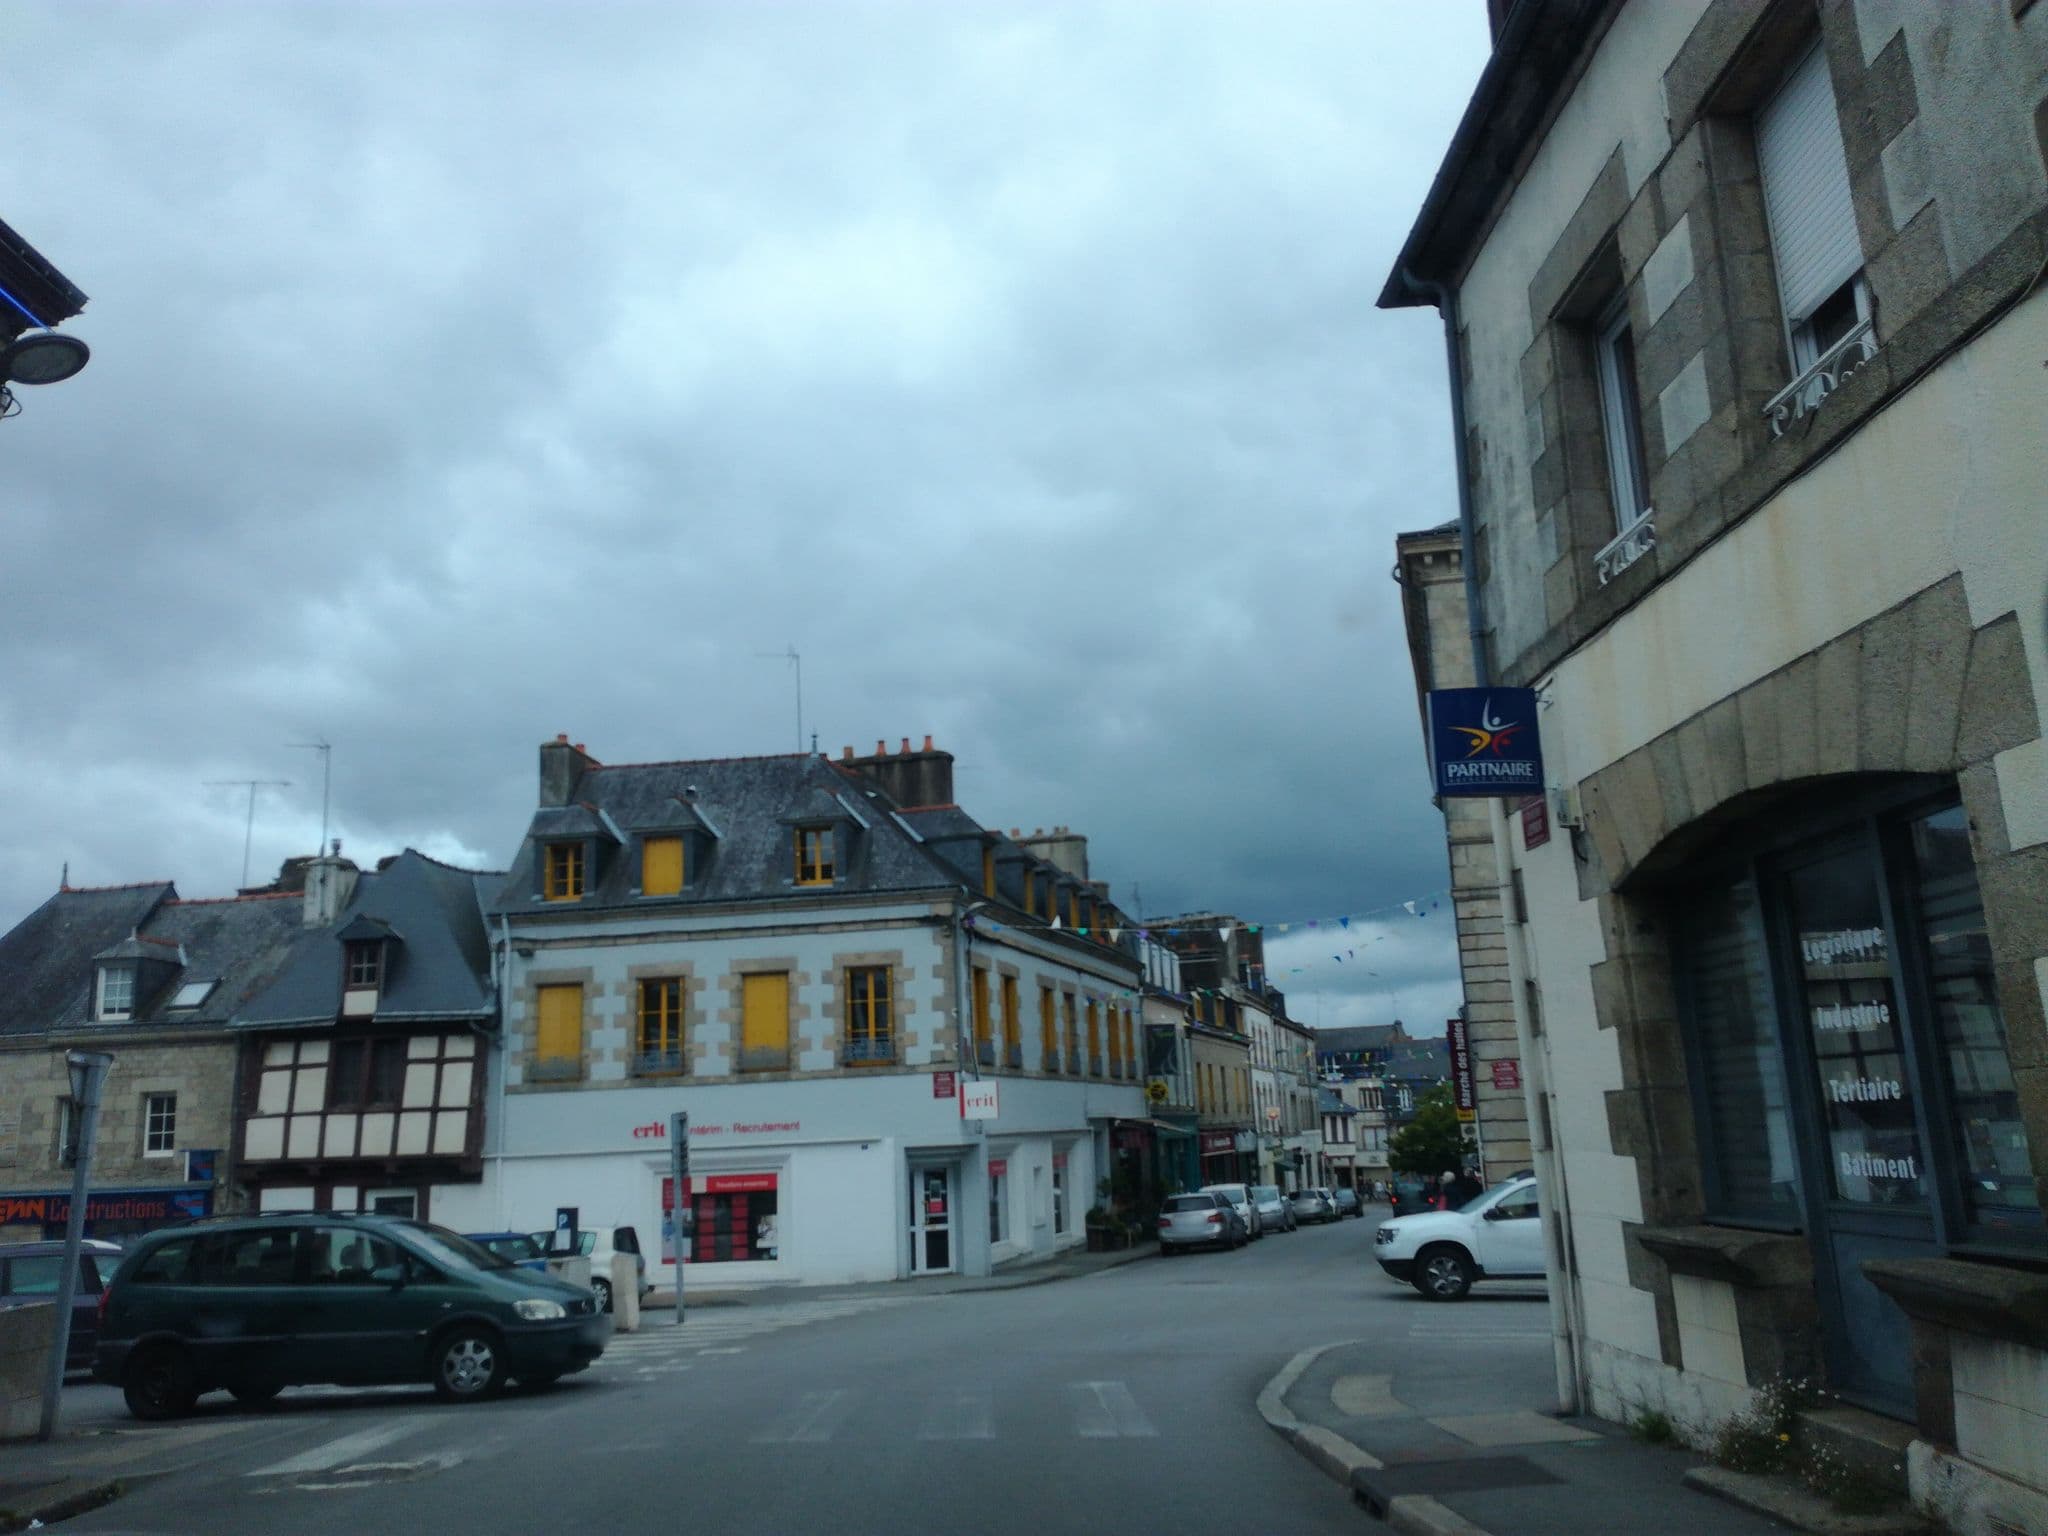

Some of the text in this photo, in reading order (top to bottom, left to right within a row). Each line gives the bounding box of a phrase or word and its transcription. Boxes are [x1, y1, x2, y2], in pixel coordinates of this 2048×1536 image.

[1447, 762, 1534, 778] PARTNAIRE
[1802, 927, 1882, 966] Logistique
[1816, 1000, 1890, 1029] Industrie
[1457, 1052, 1468, 1069] des
[1829, 1077, 1901, 1102] Tertiaire
[633, 1120, 666, 1138] crit
[689, 1123, 723, 1136] ntérim
[733, 1120, 801, 1134] Recrutement
